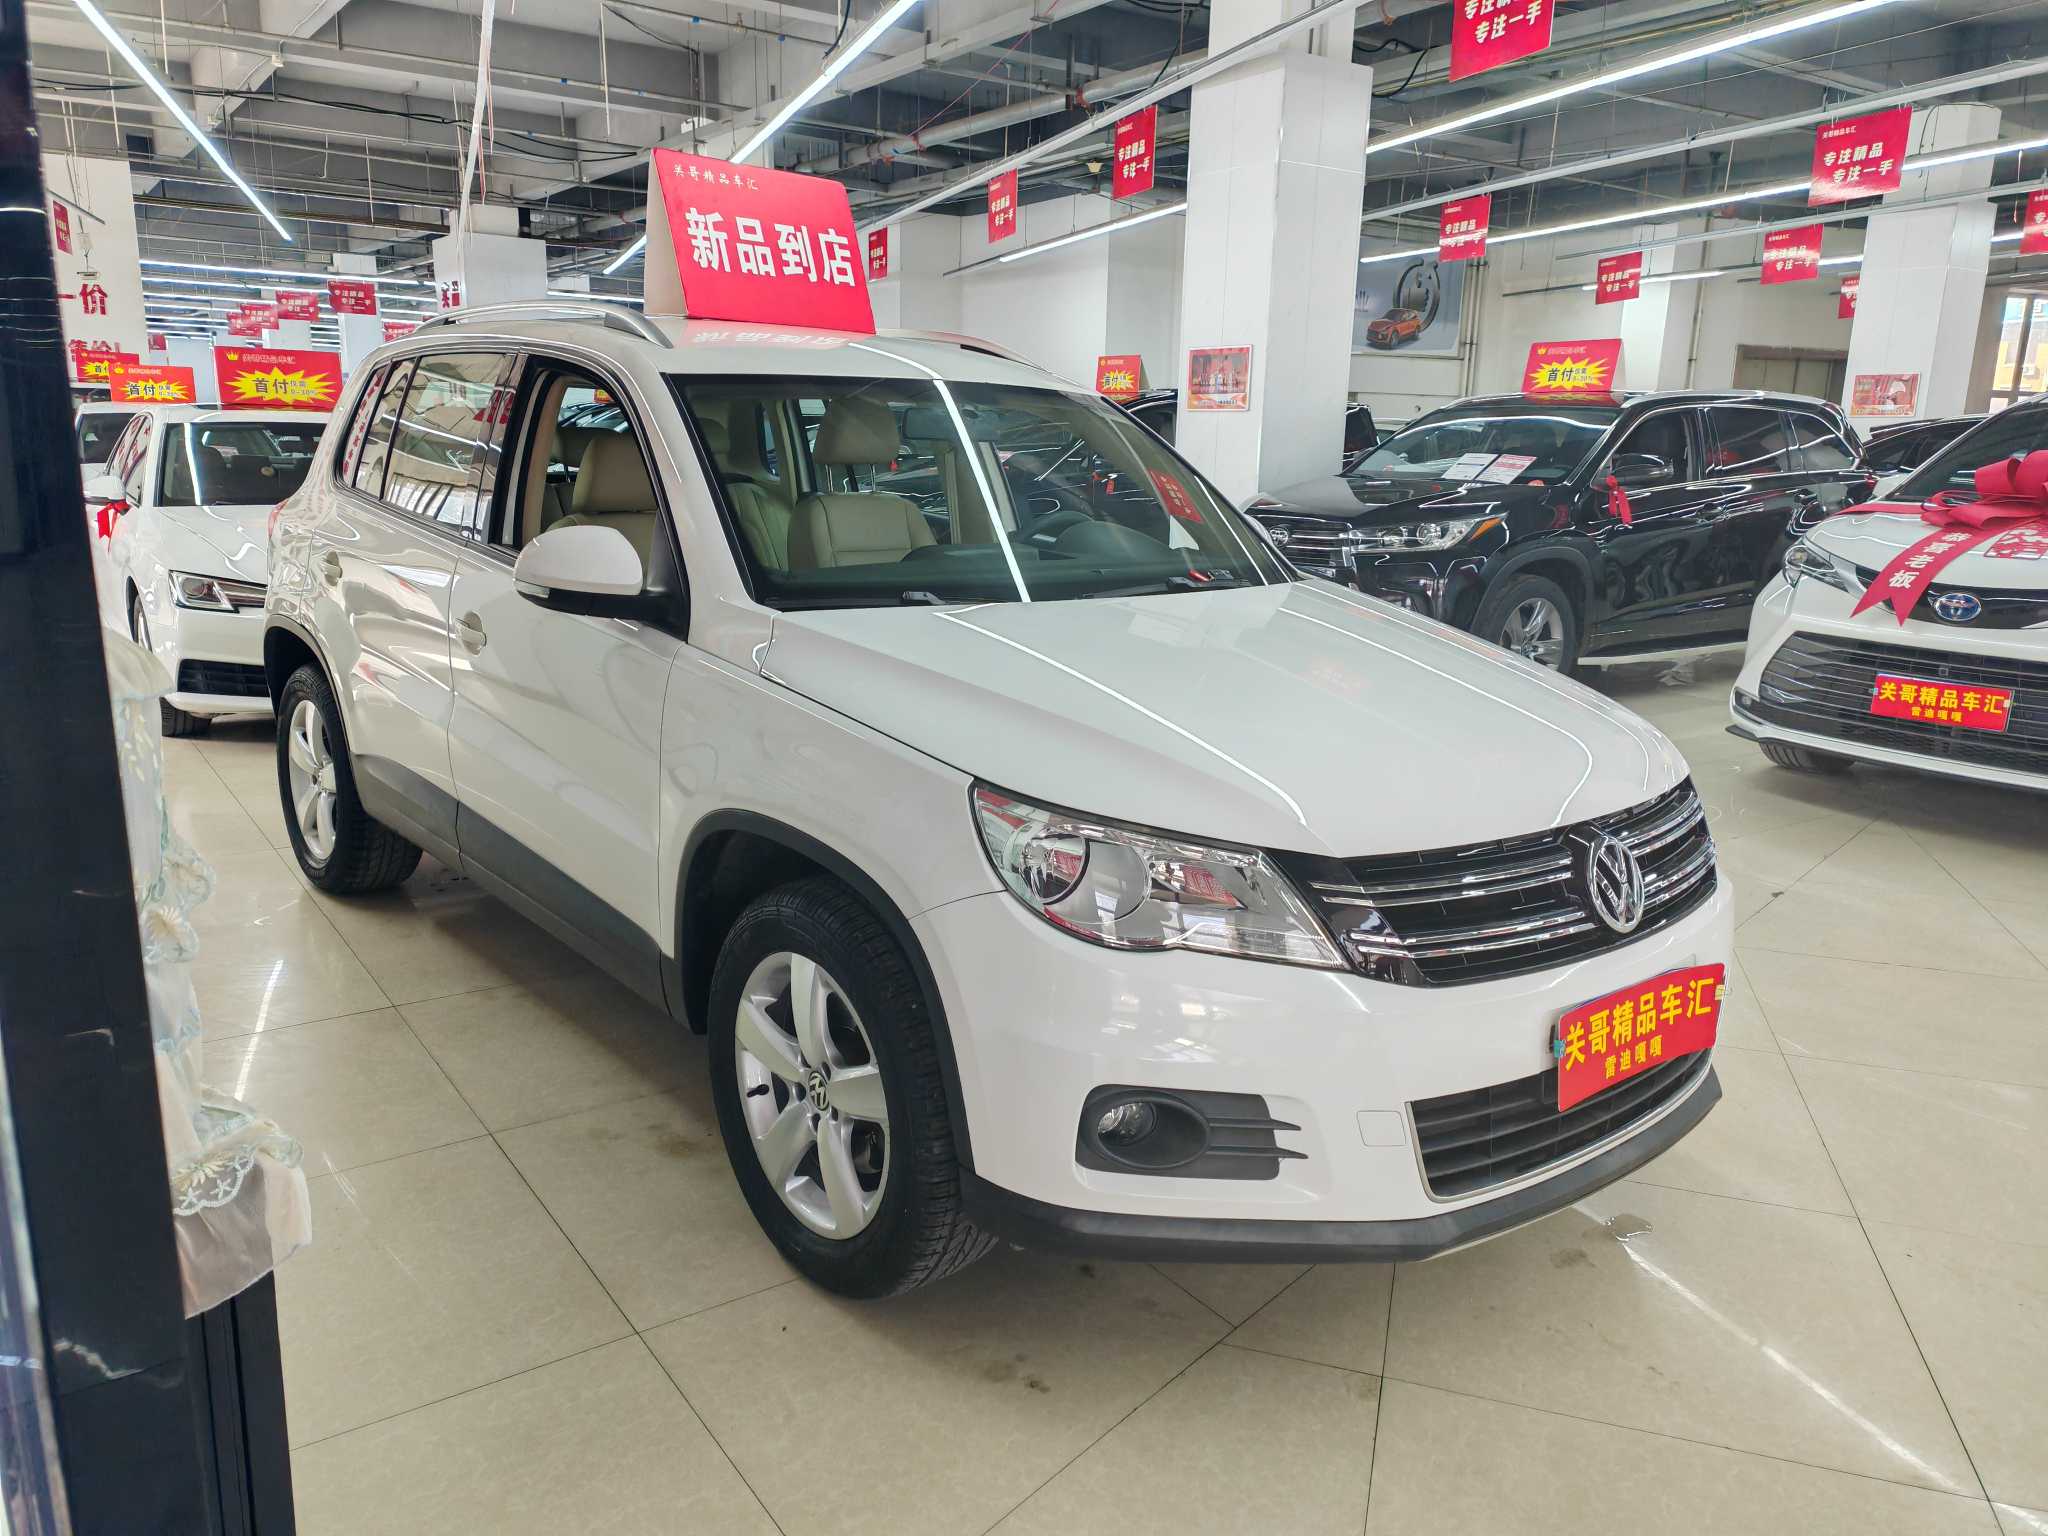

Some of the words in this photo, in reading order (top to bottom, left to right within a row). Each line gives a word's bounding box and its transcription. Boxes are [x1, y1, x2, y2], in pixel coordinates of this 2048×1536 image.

[1475, 1, 1541, 43] 专注一手
[1824, 142, 1883, 166] 专注精品
[674, 164, 759, 190] 关哥精品车汇
[1833, 159, 1894, 183] 专注一手
[685, 208, 855, 286] 新品到店
[252, 378, 289, 394] 首付
[1548, 367, 1573, 383] 首付
[129, 384, 155, 396] 首付
[1879, 682, 2005, 713] 关哥精品车汇
[1565, 977, 1714, 1071] 关哥精品车汇
[1605, 1035, 1663, 1079] 雷迪嘎嘎
